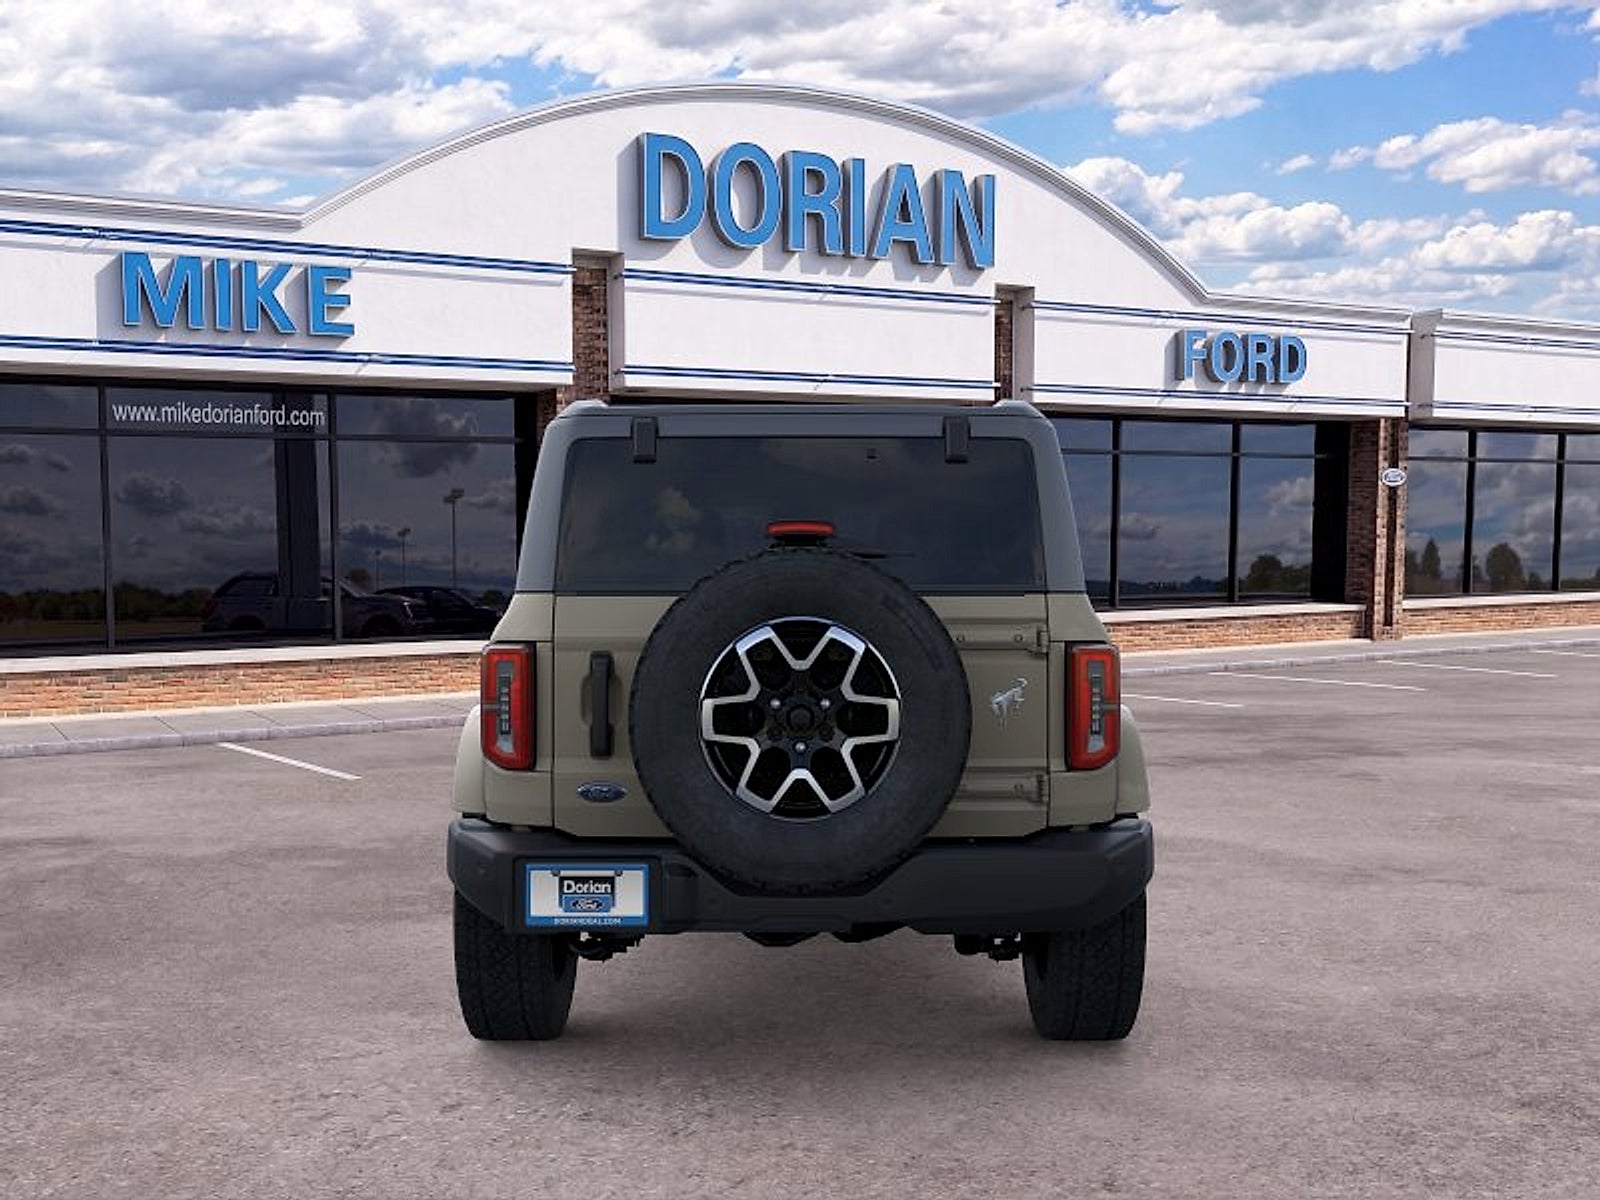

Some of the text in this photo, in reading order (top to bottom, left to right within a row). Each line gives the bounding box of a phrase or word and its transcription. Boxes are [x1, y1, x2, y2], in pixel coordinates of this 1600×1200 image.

[641, 132, 996, 269] DORIAN
[122, 251, 355, 336] MIKE
[1178, 328, 1308, 383] FORD
[112, 402, 325, 425] www.mikedorianford.com
[563, 880, 611, 893] Dorian
